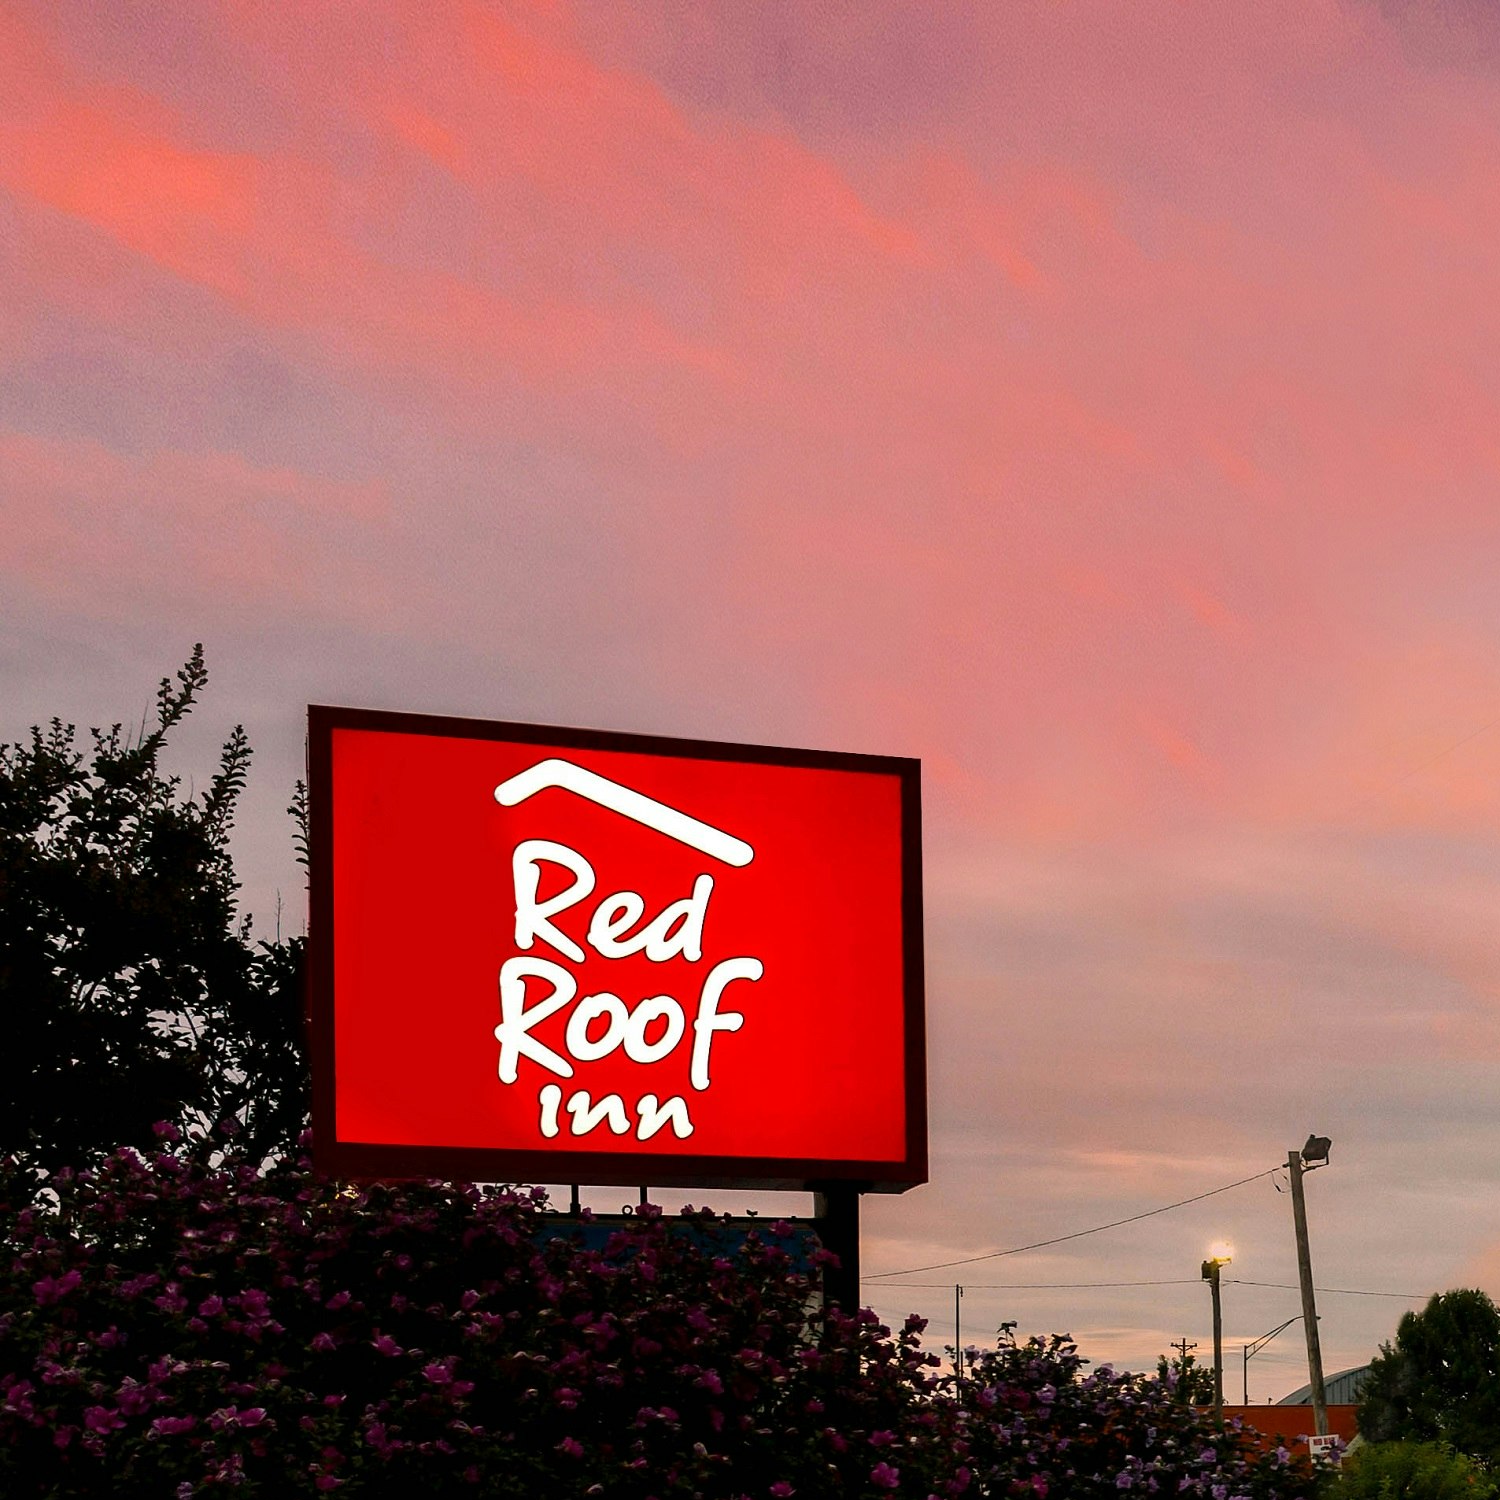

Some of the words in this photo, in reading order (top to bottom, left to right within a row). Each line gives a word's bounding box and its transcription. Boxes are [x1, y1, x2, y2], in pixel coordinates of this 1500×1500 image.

[512, 839, 715, 963] Red
[494, 956, 765, 1091] Roof
[539, 1084, 695, 1141] inn
